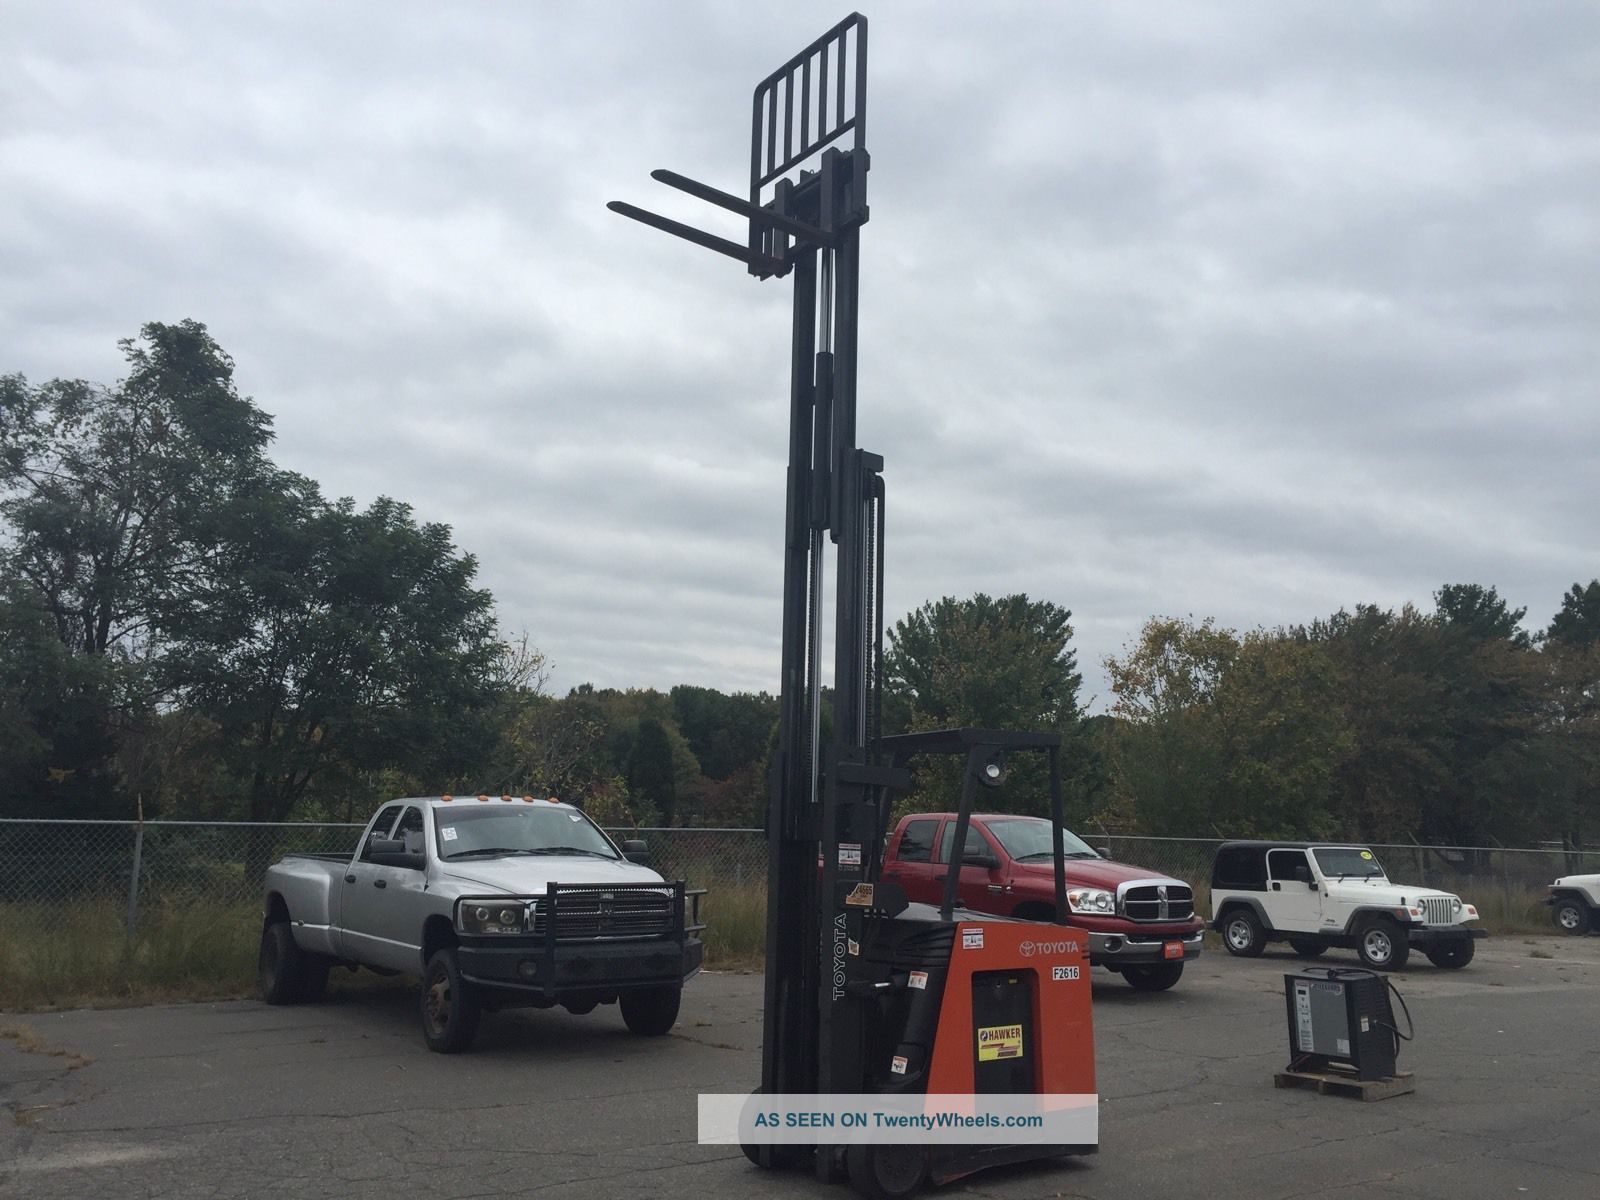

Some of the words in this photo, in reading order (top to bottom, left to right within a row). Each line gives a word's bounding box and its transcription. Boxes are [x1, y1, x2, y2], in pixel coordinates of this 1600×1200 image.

[1036, 941, 1079, 954] TOYOTA
[833, 913, 847, 1001] TOYOTA
[1054, 968, 1079, 979] F2616
[988, 1028, 1021, 1041] HAWKER
